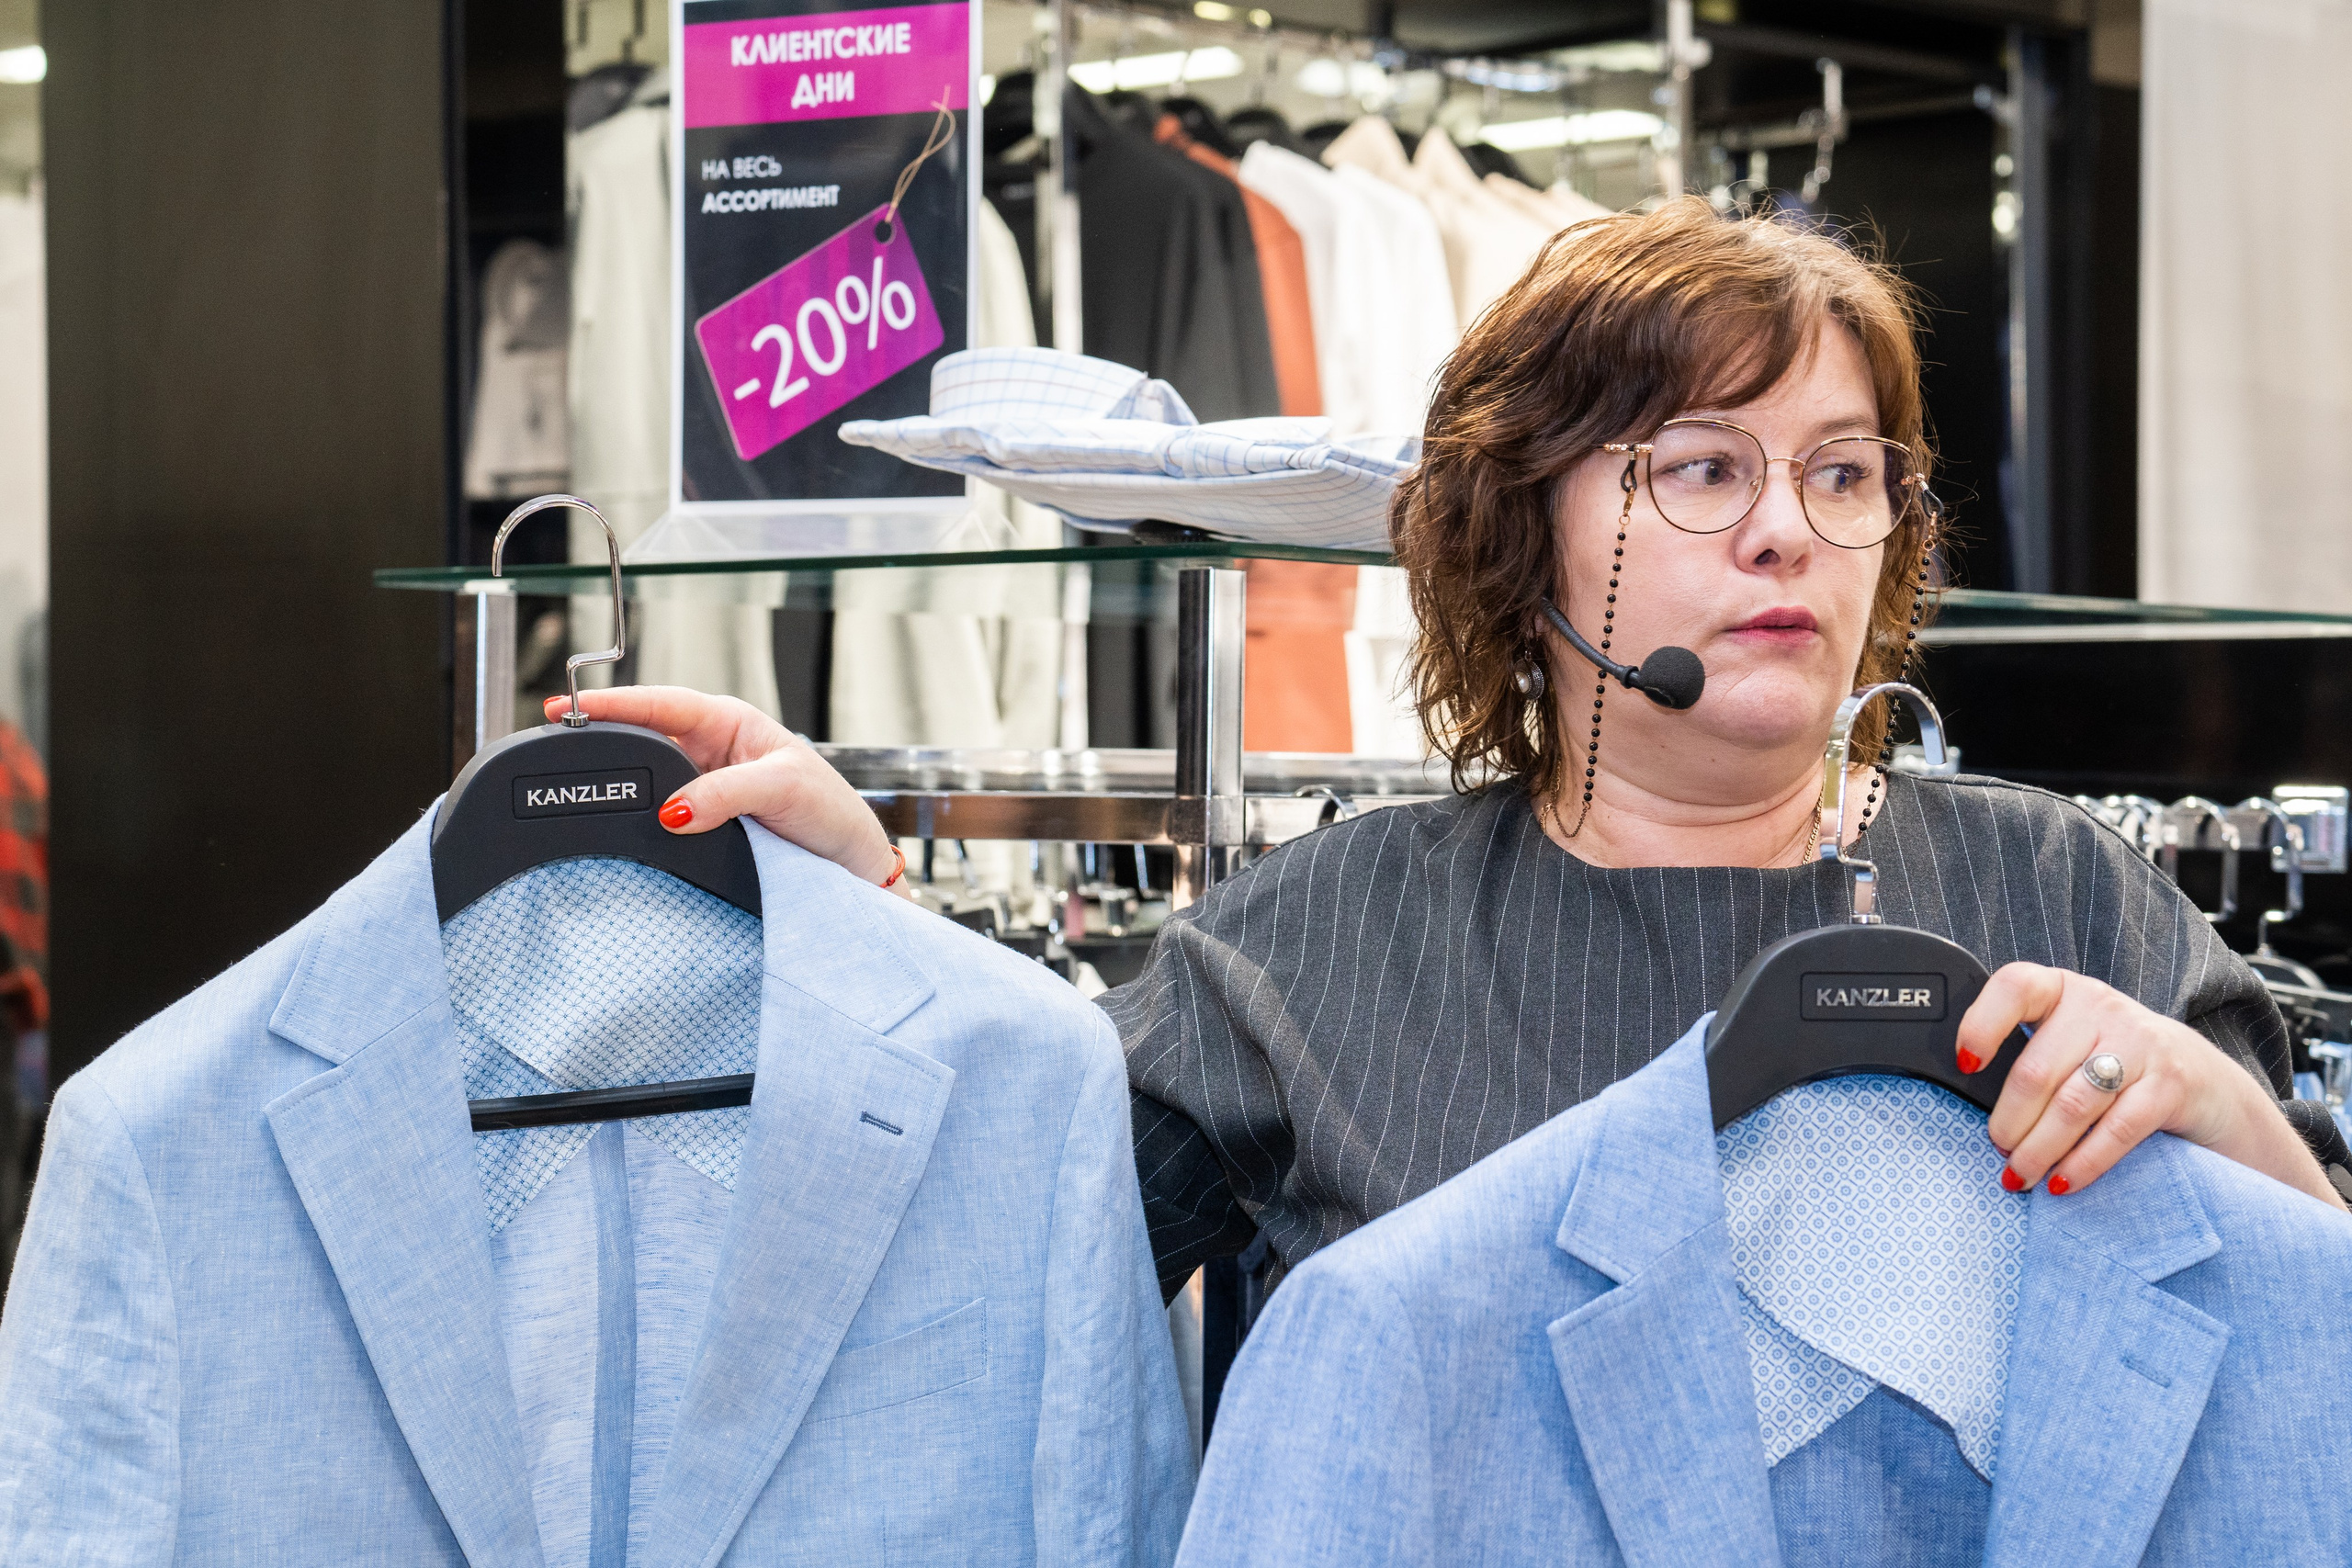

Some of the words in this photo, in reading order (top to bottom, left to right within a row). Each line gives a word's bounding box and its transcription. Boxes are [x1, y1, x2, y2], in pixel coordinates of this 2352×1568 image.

[730, 22, 911, 67] КЛИЕНТСКИЕ
[791, 71, 854, 109] ДНИ
[701, 159, 730, 181] НА
[732, 155, 782, 179] ВЕСЬ
[701, 185, 841, 214] АССОРТИМЕНТ
[733, 256, 917, 409] -20%
[526, 782, 638, 807] KANZLER
[1815, 987, 1931, 1008] KANZLER
